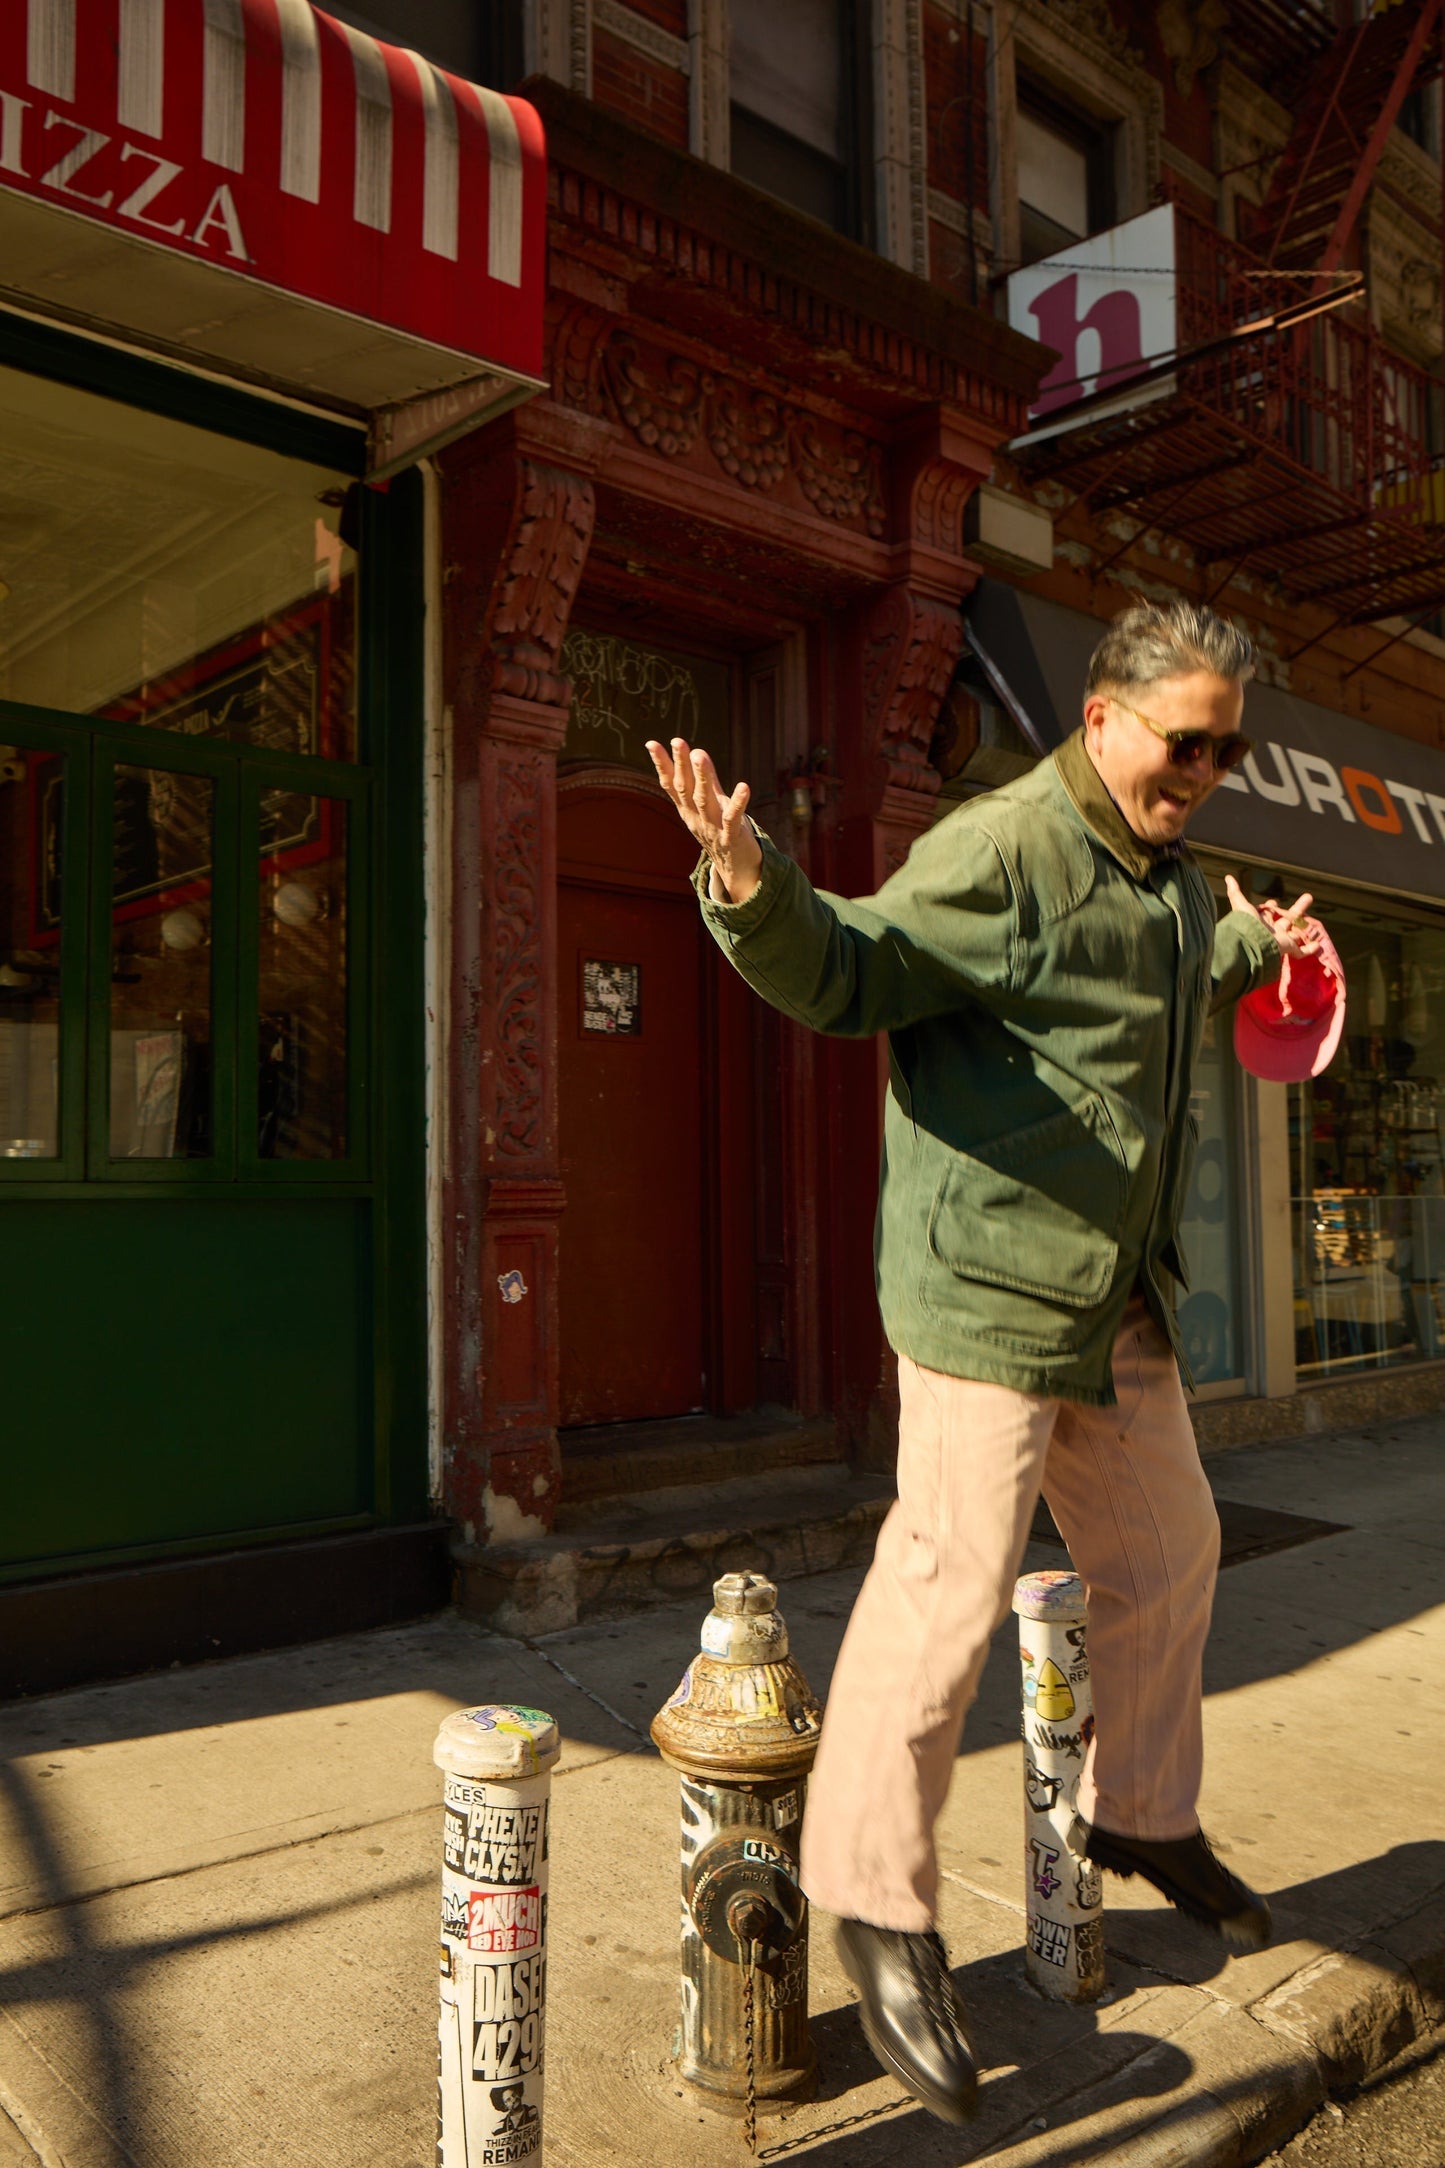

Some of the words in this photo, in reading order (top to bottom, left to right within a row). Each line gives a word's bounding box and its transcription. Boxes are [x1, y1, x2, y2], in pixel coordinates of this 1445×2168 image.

[0, 90, 257, 265] IZZA
[1219, 742, 1445, 845] UROT
[471, 1893, 539, 1937] 2MUCH
[473, 2012, 540, 2080] 429
[486, 2137, 512, 2148] THIZZ
